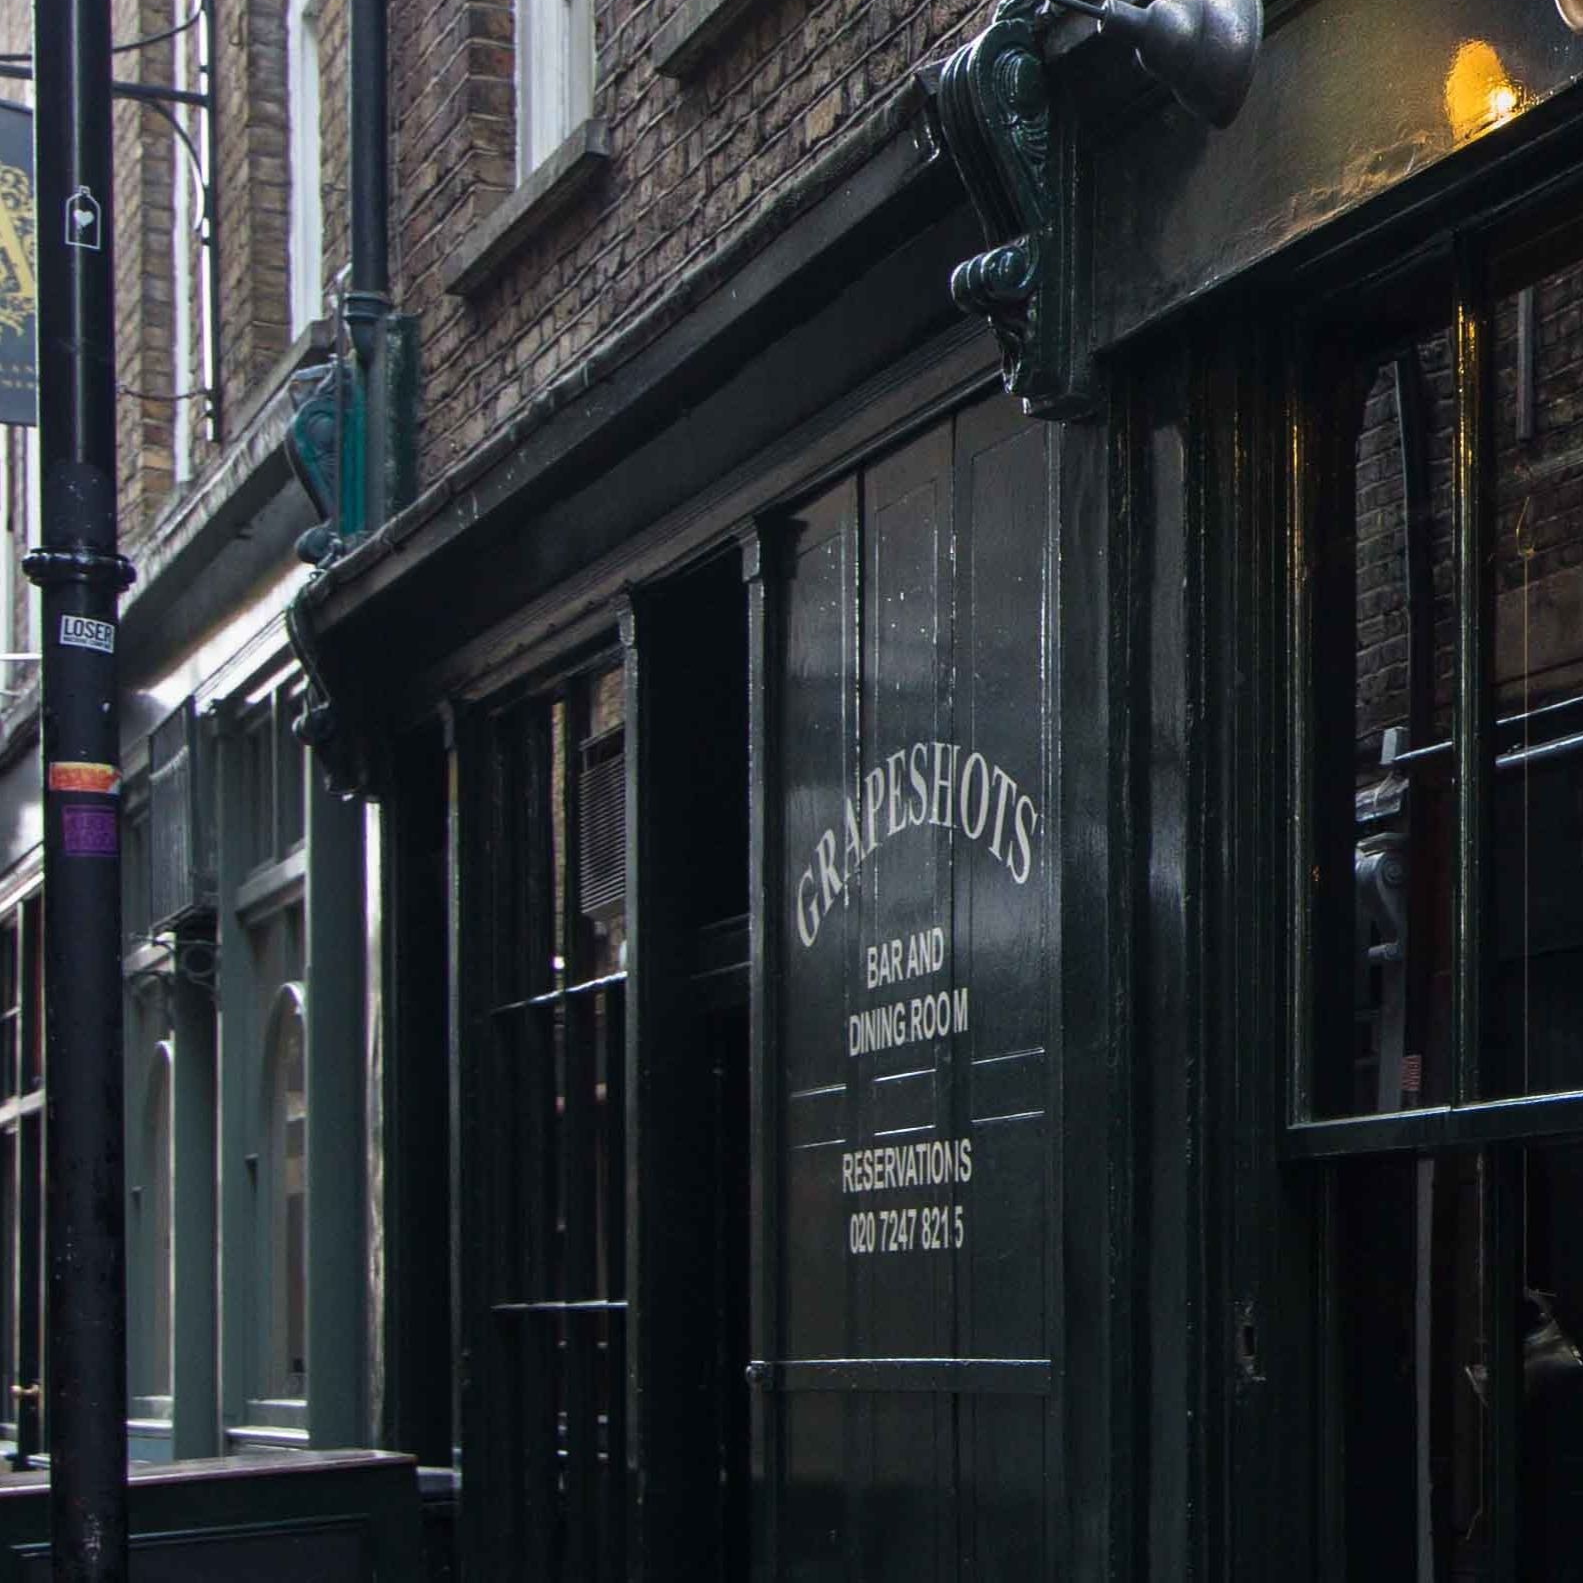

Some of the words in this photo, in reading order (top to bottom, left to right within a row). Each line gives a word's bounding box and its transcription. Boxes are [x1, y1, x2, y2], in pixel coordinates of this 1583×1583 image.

[64, 617, 112, 642] LOSER
[797, 741, 1038, 948] GRAPESHOTS
[866, 942, 903, 989] BAR
[907, 926, 944, 978] AND
[849, 1003, 906, 1057] DINING
[911, 987, 969, 1042] ROOM
[842, 1138, 972, 1193] RESERVATIONS
[850, 1212, 876, 1255] 020
[879, 1209, 918, 1251] 7247
[922, 1205, 964, 1250] 8215
